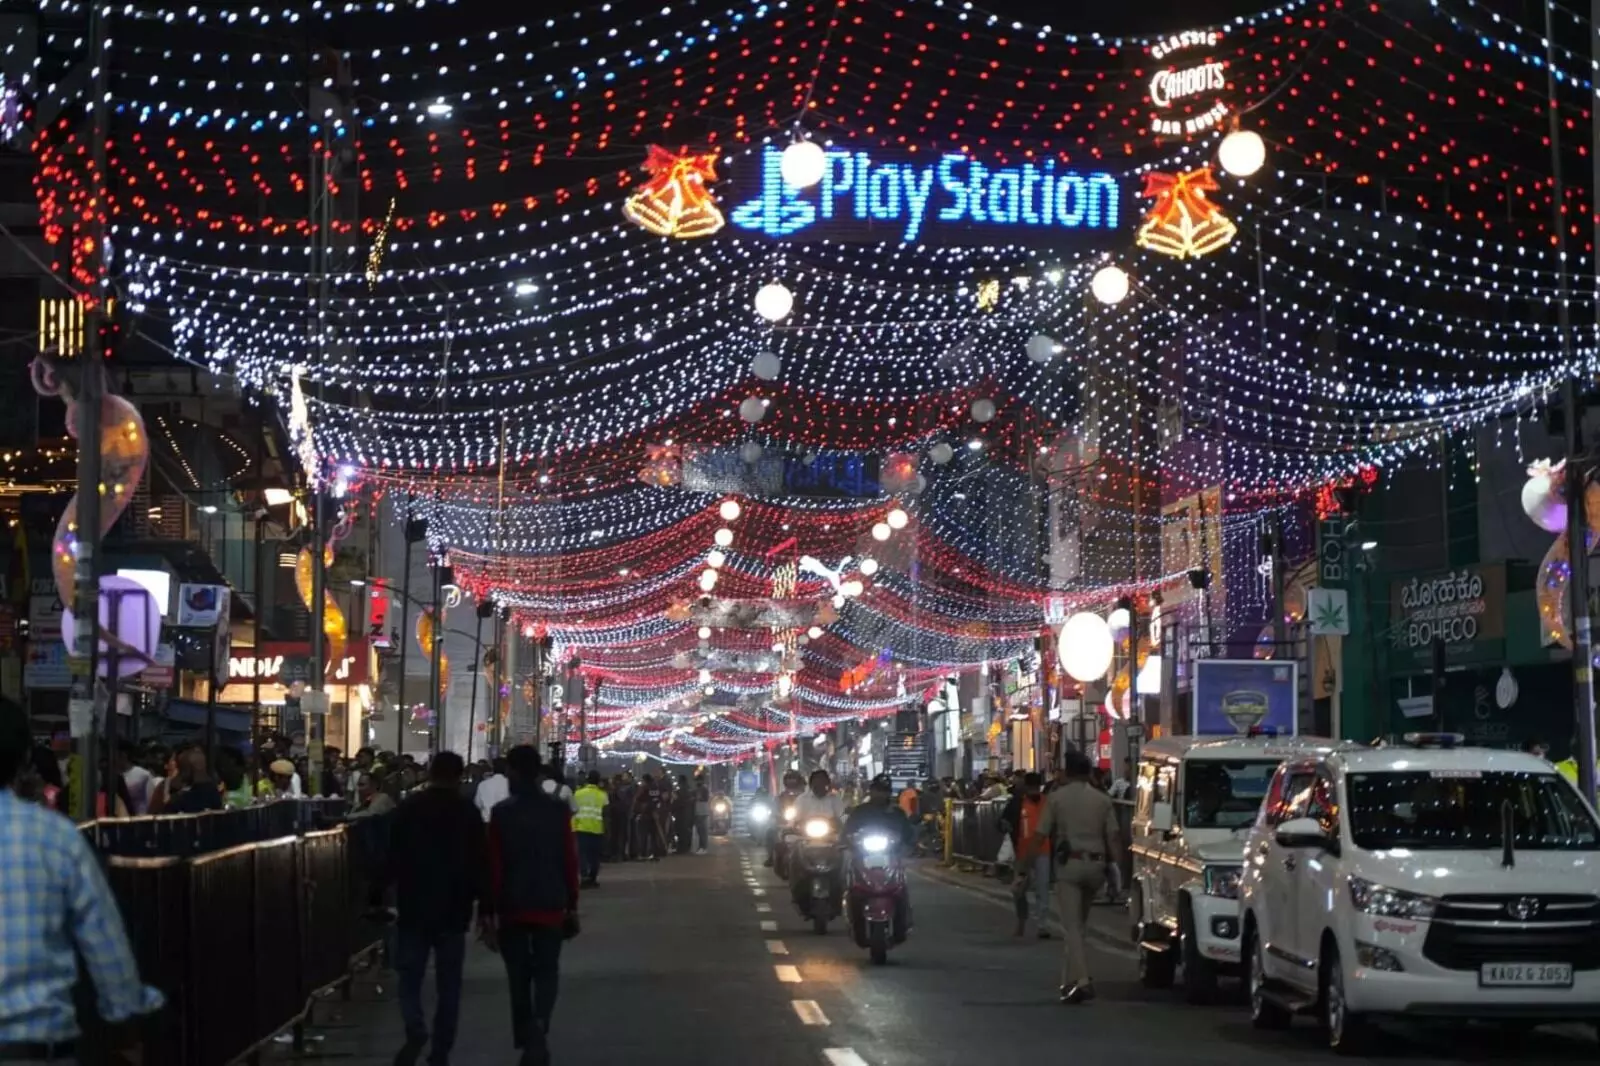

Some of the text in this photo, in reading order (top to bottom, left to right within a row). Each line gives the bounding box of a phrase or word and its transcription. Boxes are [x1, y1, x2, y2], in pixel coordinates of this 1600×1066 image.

[1150, 30, 1218, 60] CLASSIC
[1148, 61, 1225, 107] CAHOOTS
[1151, 102, 1229, 135] BAR HOUSE
[820, 150, 1120, 241] PlayStation
[1408, 615, 1477, 648] BOHECO
